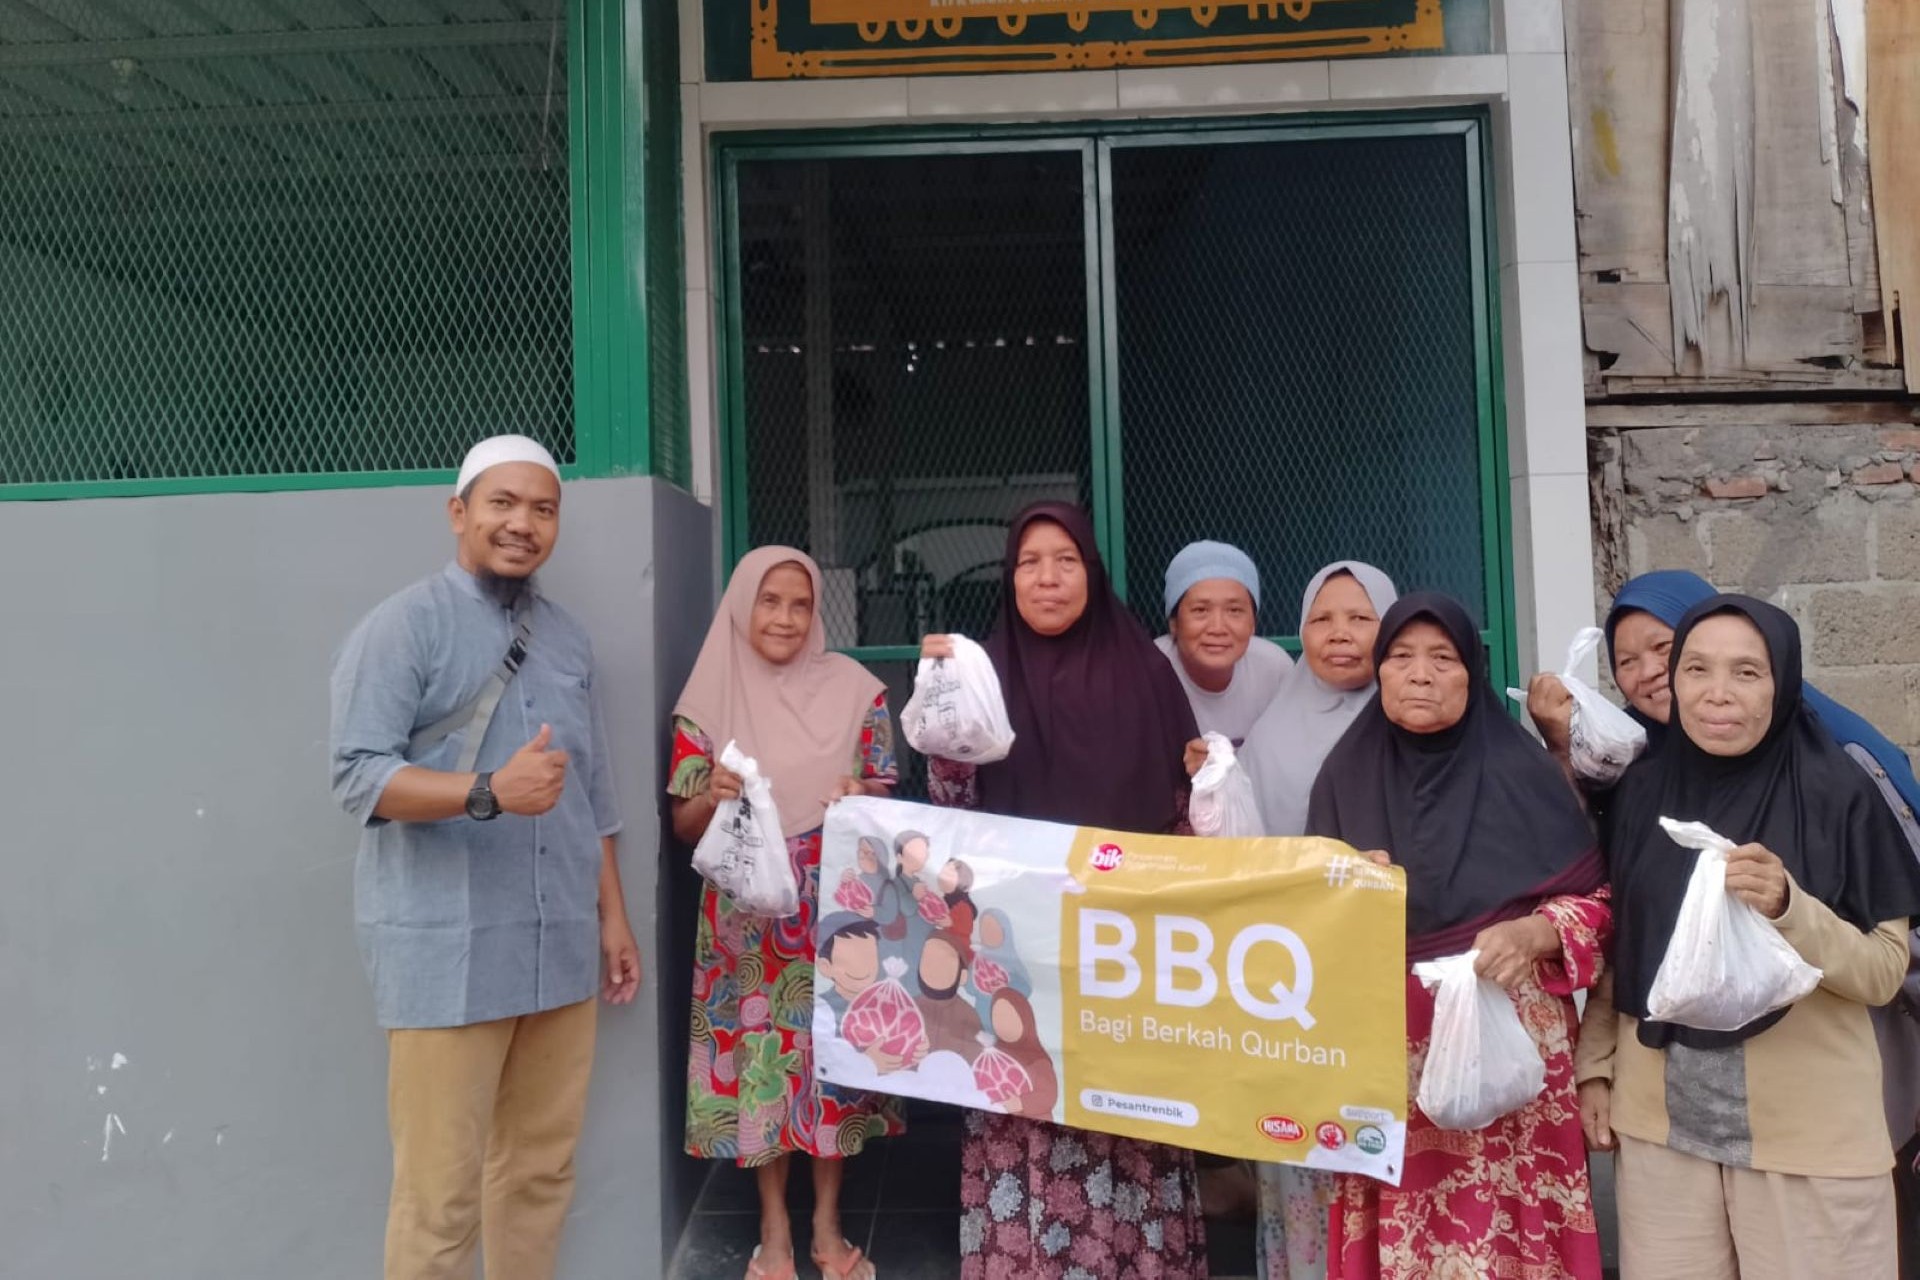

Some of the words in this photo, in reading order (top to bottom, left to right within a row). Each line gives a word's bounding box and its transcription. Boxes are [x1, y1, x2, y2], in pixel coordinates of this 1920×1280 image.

[1090, 847, 1122, 868] bik
[1324, 854, 1351, 888] #
[1079, 908, 1317, 1031] BBQ
[1080, 1009, 1132, 1043] Bagi
[1142, 1016, 1232, 1051] Berkah
[1241, 1030, 1346, 1067] Qurban
[1107, 1098, 1184, 1119] Pesantrenbik
